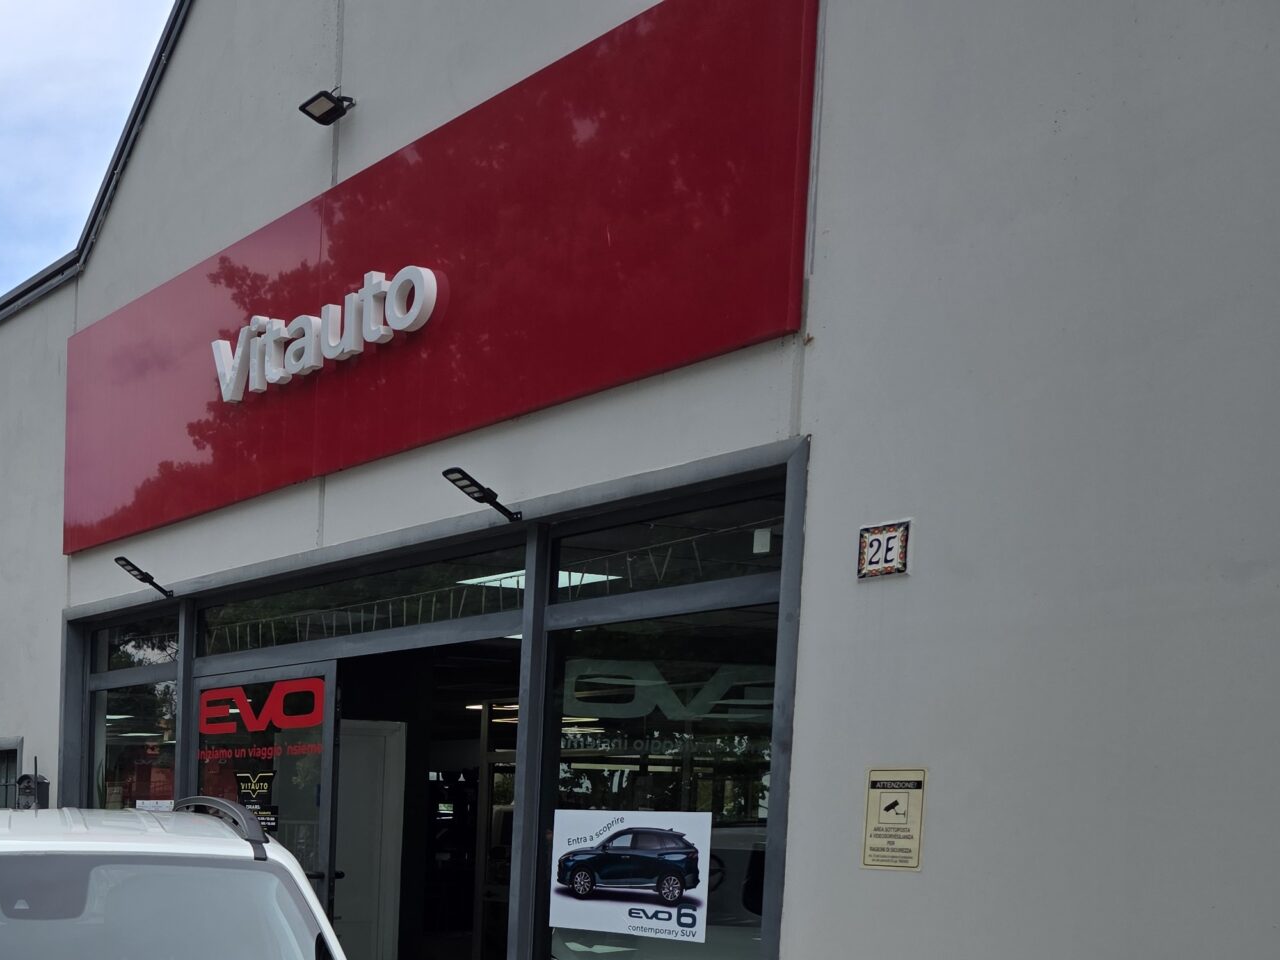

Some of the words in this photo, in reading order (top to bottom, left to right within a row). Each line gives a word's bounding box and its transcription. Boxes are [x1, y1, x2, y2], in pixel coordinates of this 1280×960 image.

[211, 265, 437, 403] Vitauto
[868, 535, 897, 565] 2E
[199, 677, 324, 734] EVO
[235, 747, 246, 758] un
[248, 744, 282, 760] viaggio
[240, 782, 268, 790] VITAUTO
[567, 836, 587, 846] Entra
[595, 815, 625, 839] scoprire
[628, 907, 672, 922] EVO
[676, 903, 697, 928] 6
[628, 924, 679, 938] contemporary
[681, 929, 697, 938] SUV
